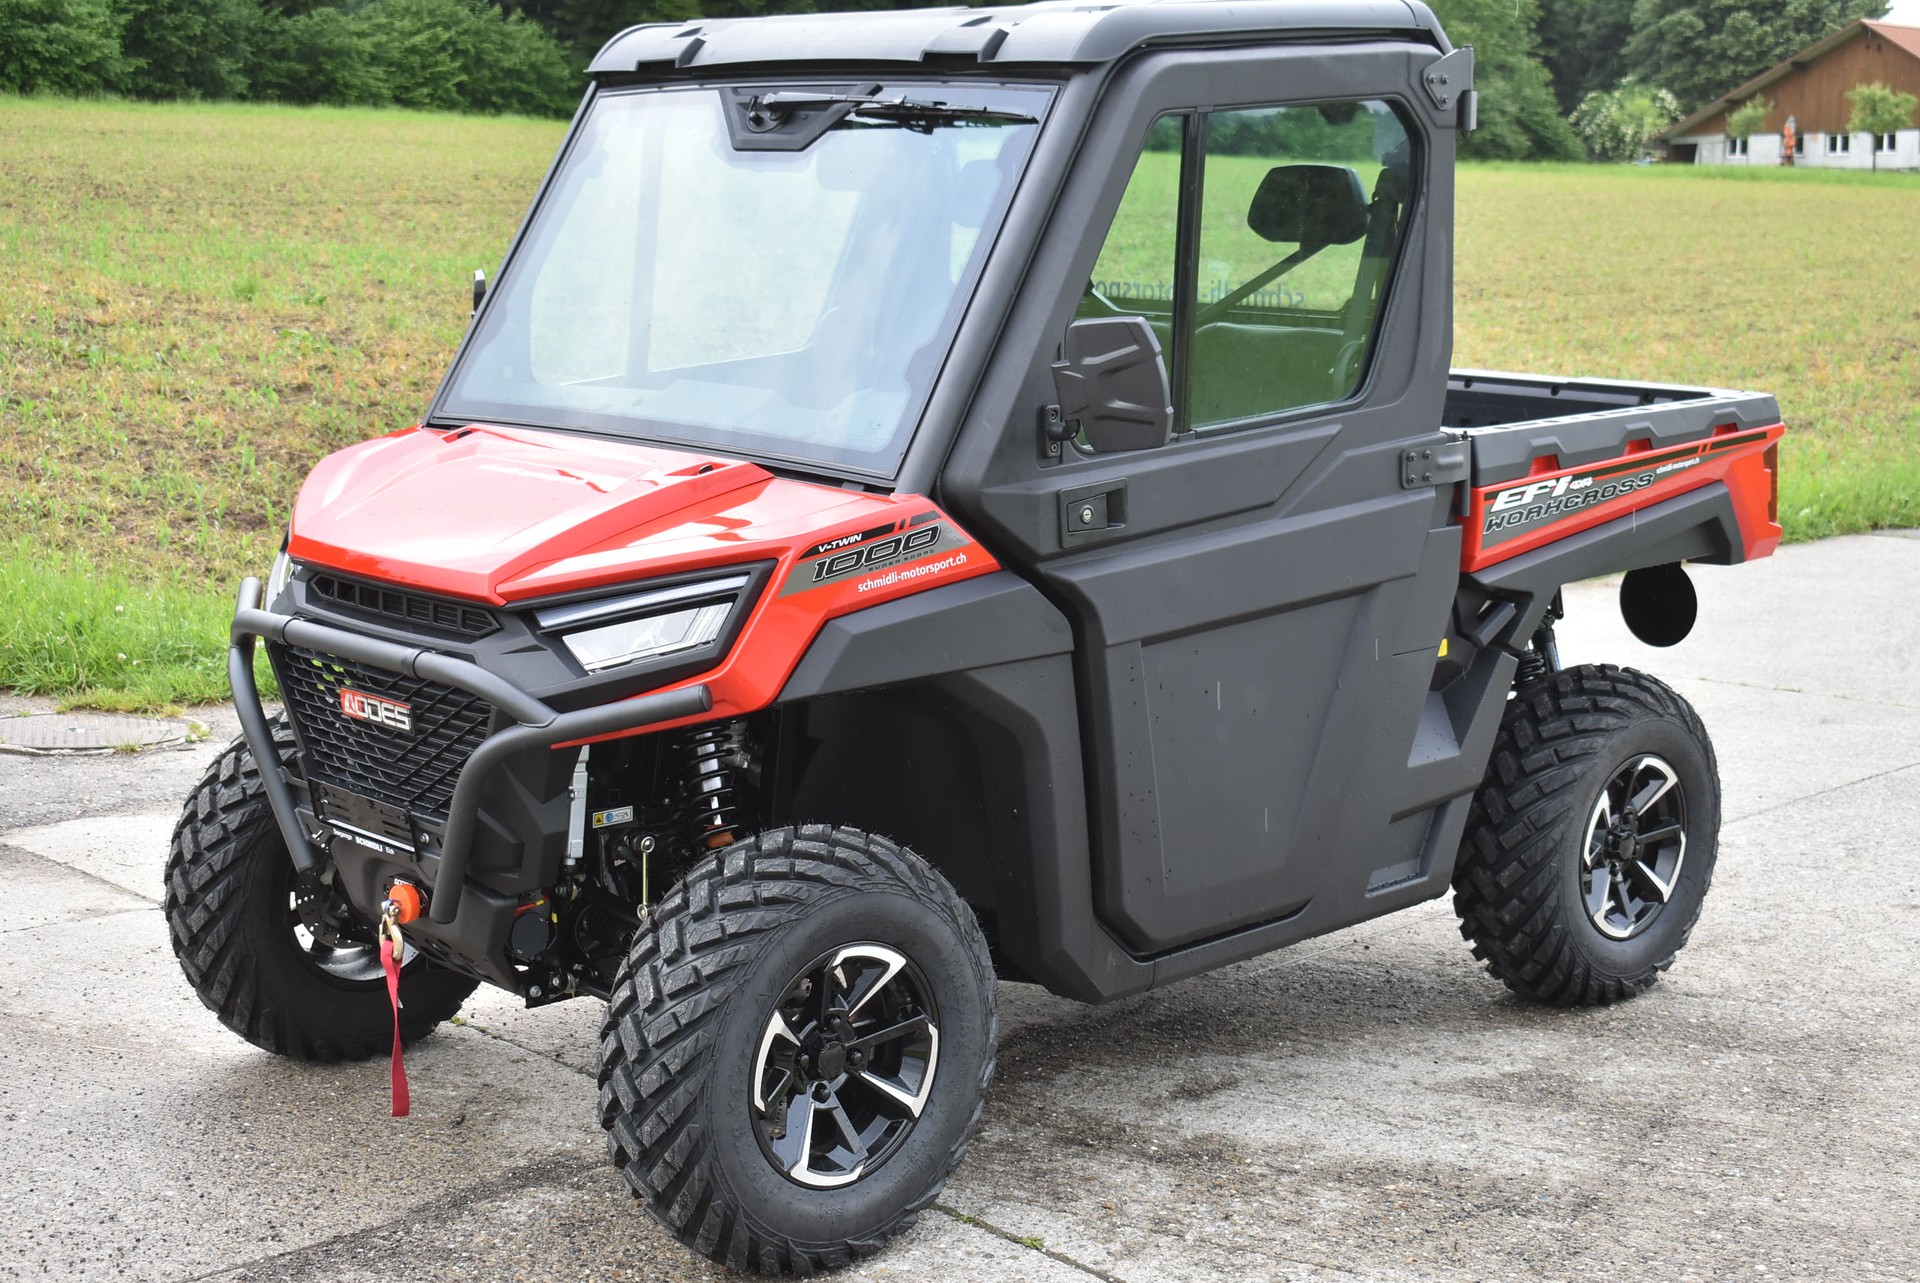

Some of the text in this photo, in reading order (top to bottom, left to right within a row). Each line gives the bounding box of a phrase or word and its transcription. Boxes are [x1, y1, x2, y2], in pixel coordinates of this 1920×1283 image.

[1482, 472, 1655, 535] WORKCROSS
[1490, 475, 1573, 513] EFI
[812, 523, 941, 582] 1000
[818, 533, 862, 552] V-TWIN
[858, 552, 967, 592] schmidli-motorsport.ch
